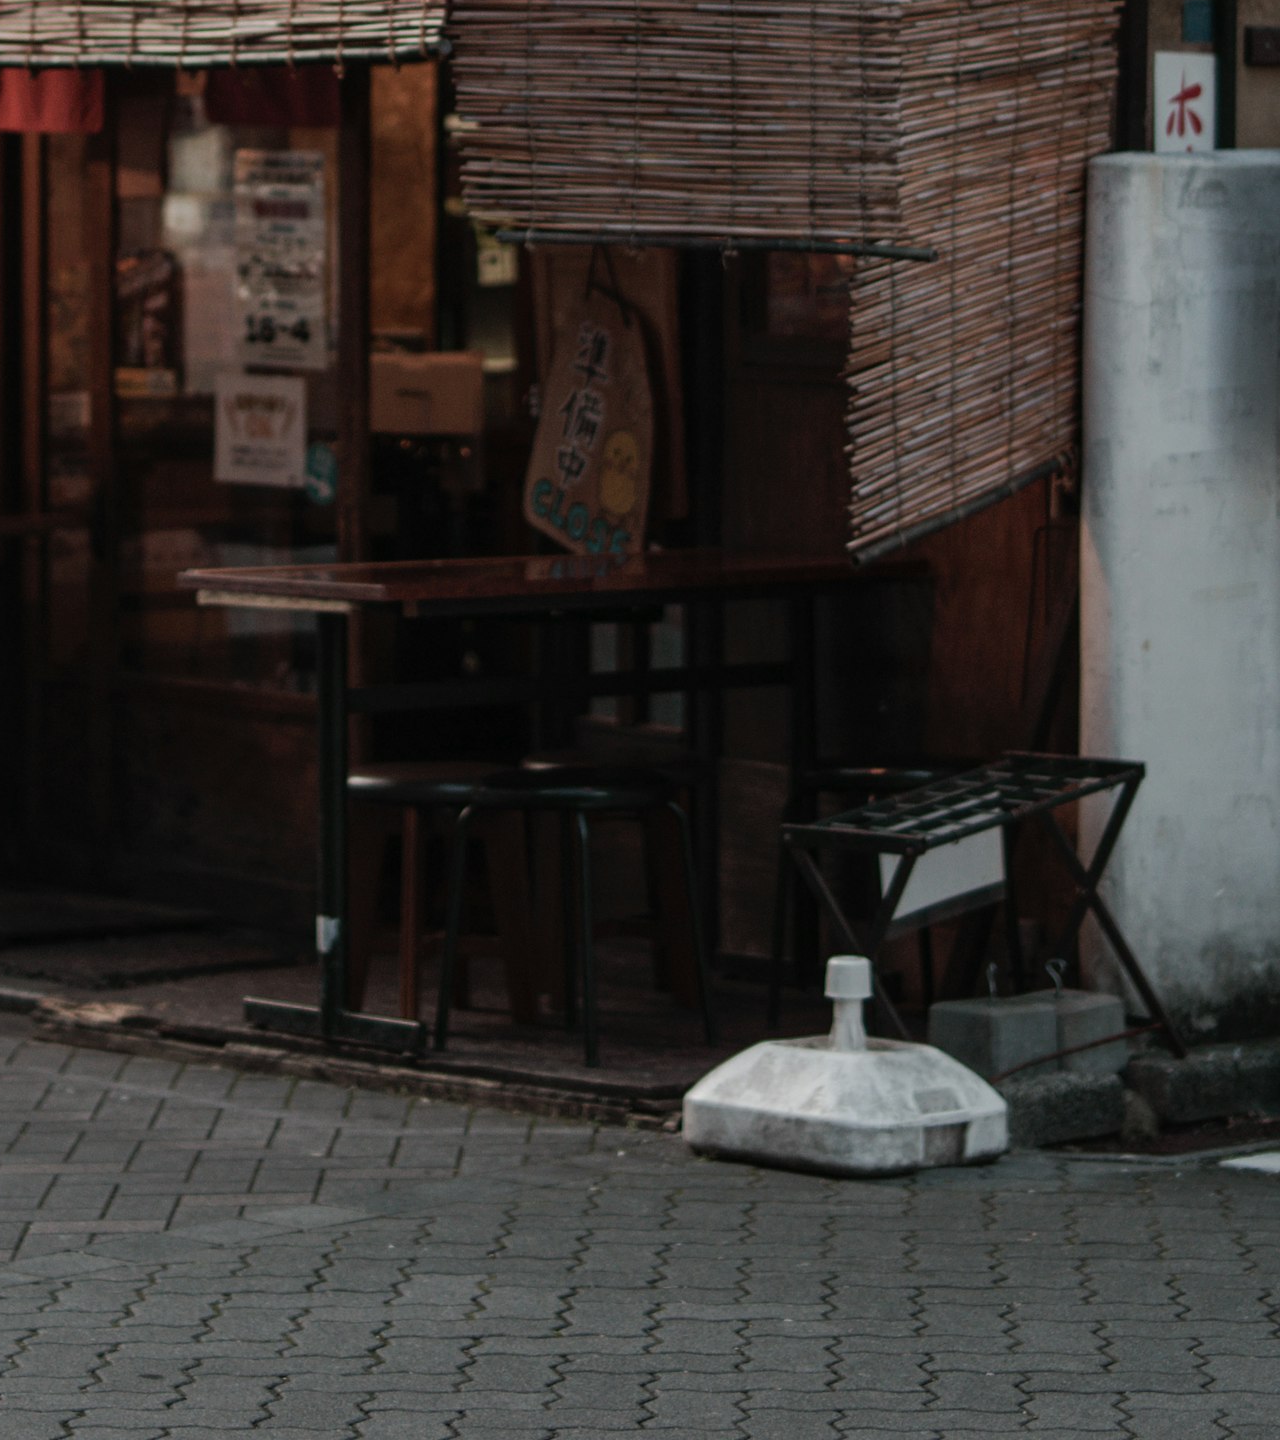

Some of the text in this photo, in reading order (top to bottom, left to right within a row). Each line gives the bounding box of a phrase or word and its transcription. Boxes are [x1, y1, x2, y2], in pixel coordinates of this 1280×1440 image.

[557, 320, 608, 489] 準備中
[531, 477, 631, 555] CLOSE
